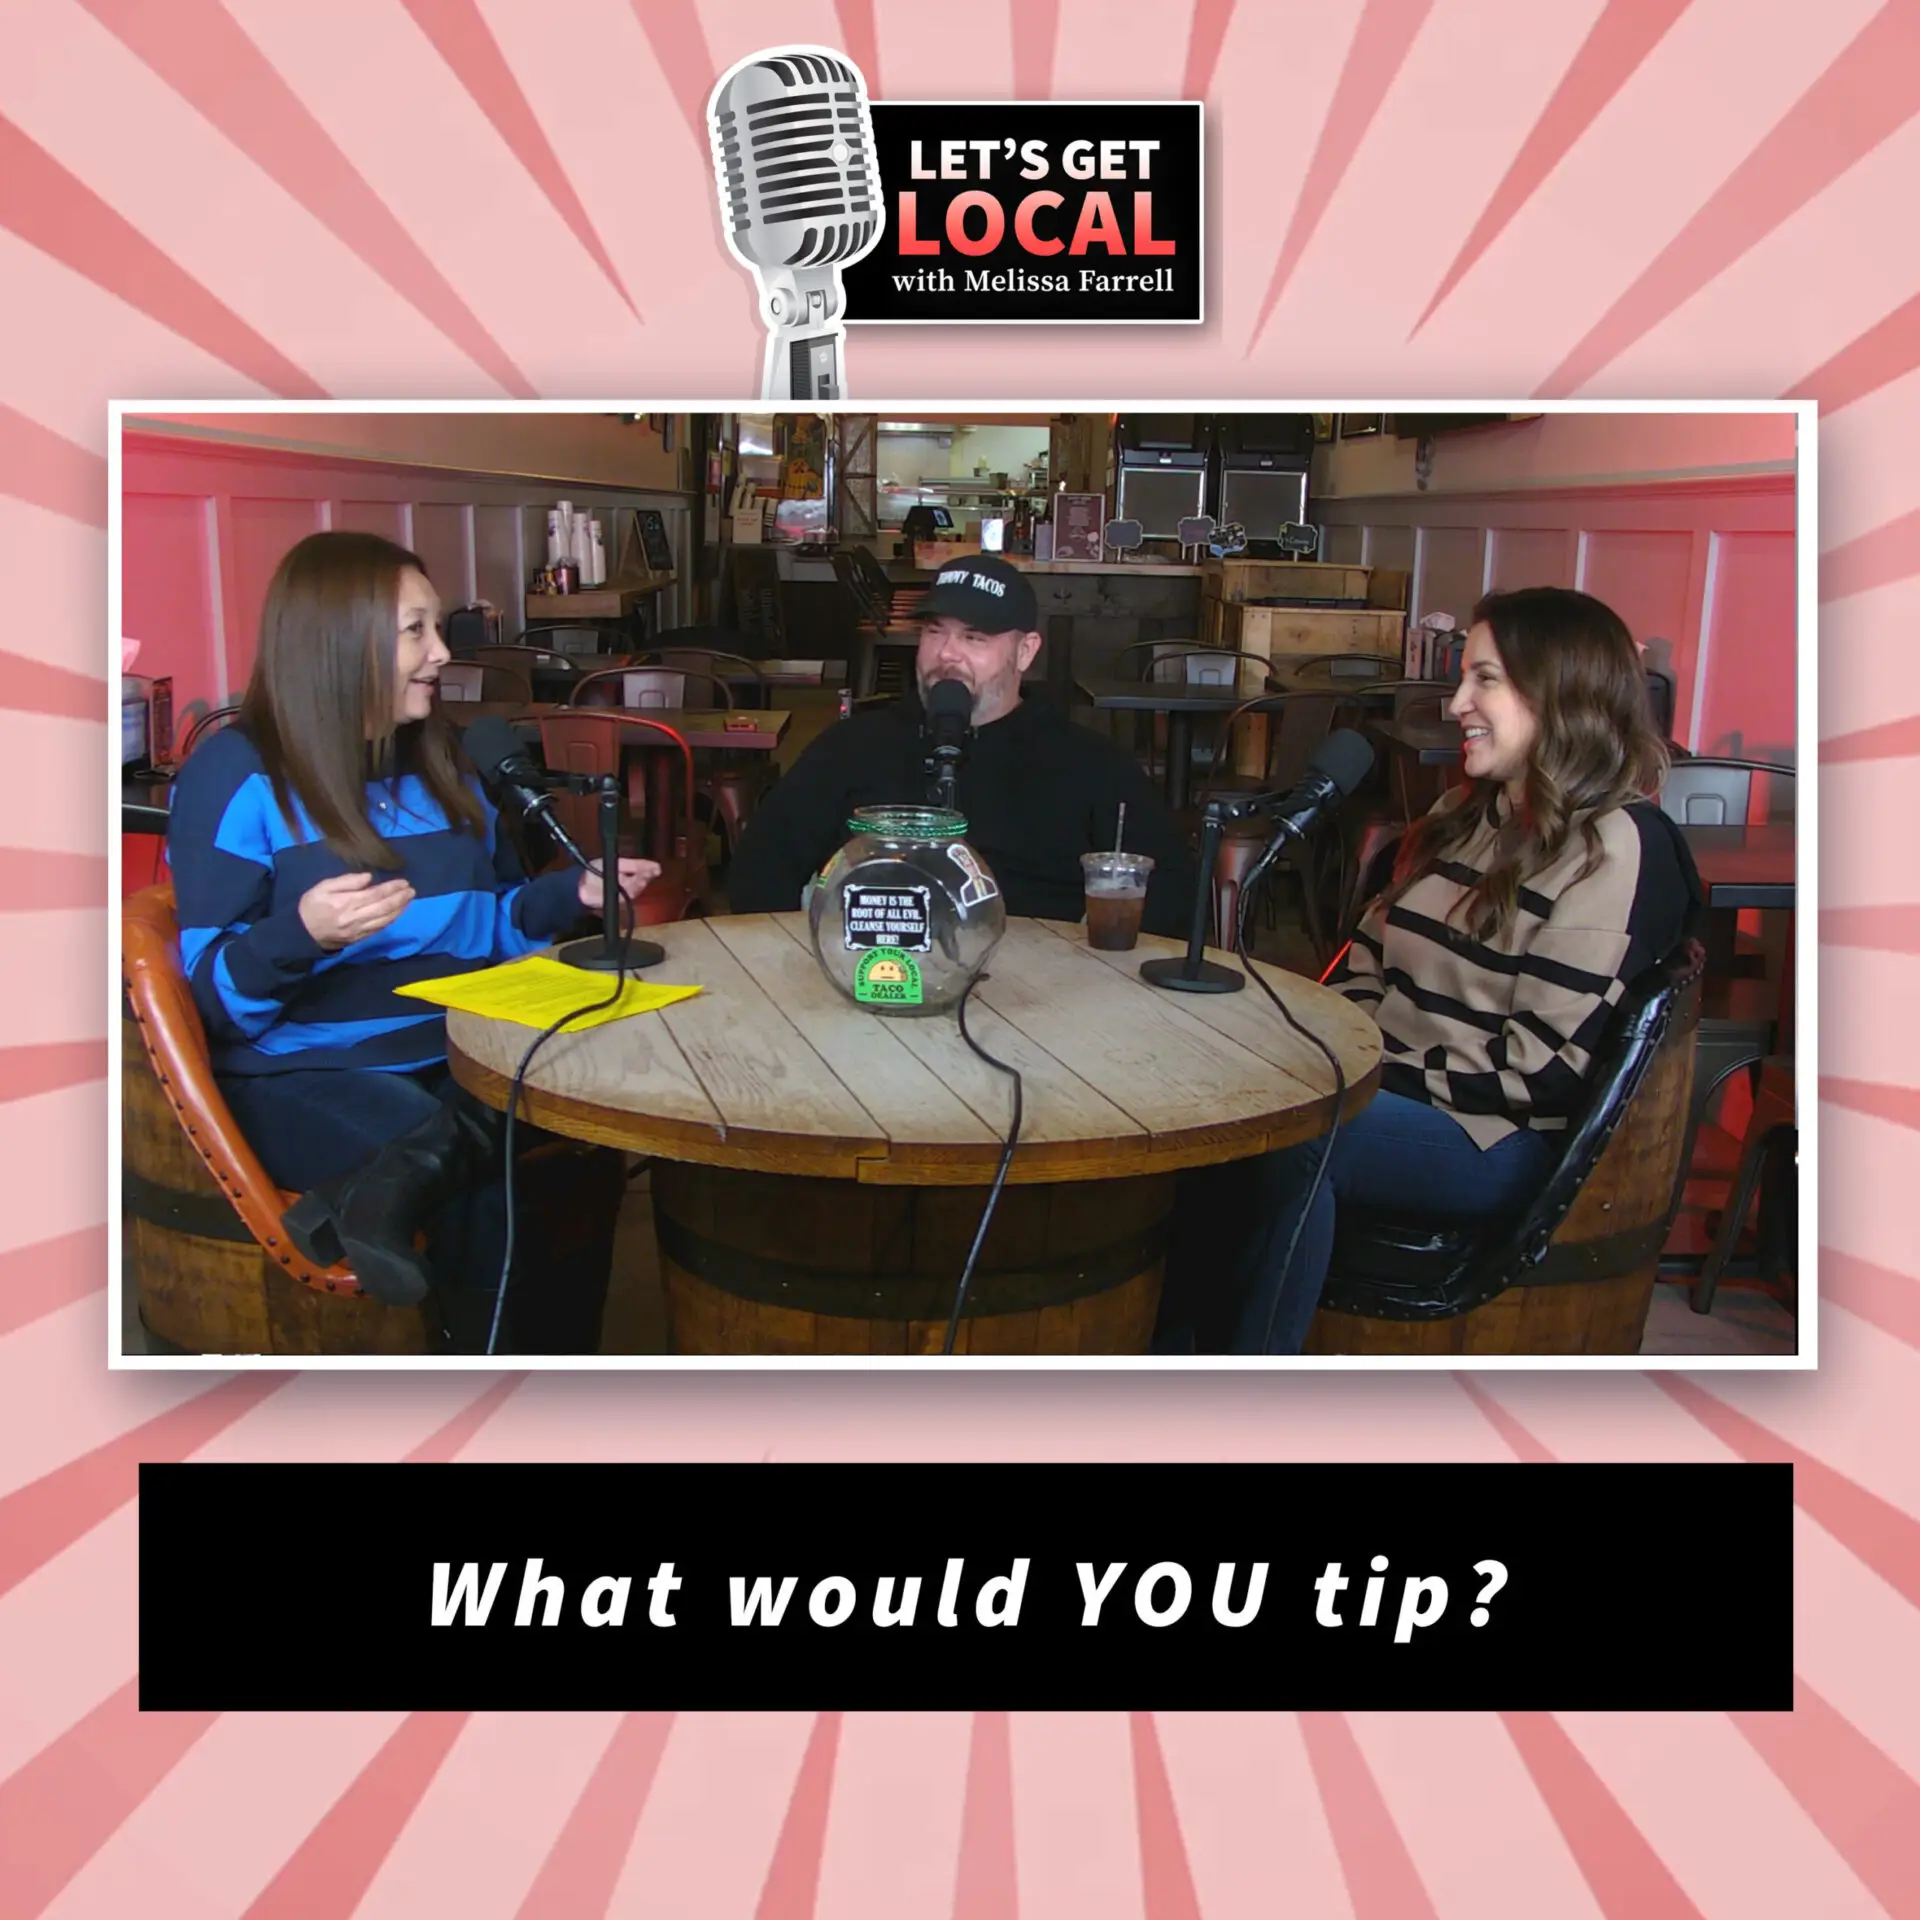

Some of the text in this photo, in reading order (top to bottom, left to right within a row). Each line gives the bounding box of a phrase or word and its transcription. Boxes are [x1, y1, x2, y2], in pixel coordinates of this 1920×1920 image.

[972, 573, 1006, 597] TACOS
[859, 895, 915, 906] MONEY IS THE
[851, 908, 873, 919] ROOT
[874, 908, 886, 919] OF
[886, 908, 901, 919] ALL
[850, 921, 925, 933] CLEANSE YOURSELF
[858, 951, 878, 987] SUPPORT
[905, 959, 919, 989] LOCAL
[872, 984, 904, 992] TACO
[871, 991, 906, 1000] DEALER
